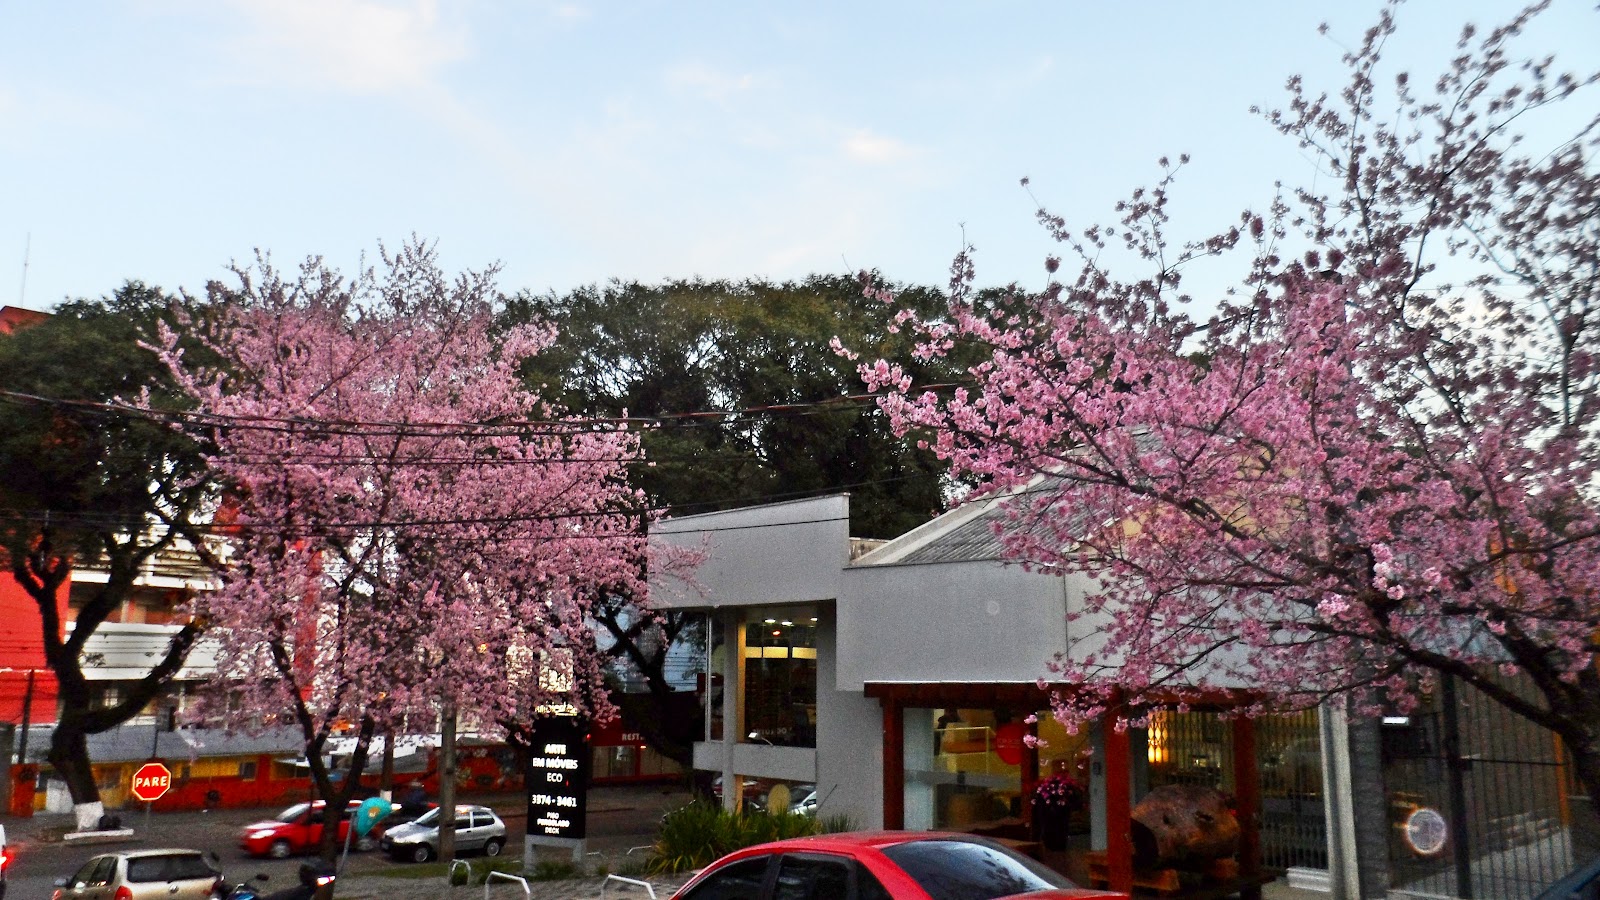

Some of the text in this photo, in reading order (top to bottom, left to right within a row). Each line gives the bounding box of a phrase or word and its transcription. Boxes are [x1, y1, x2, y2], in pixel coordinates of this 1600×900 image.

[545, 744, 566, 754] ARTE
[533, 756, 578, 769] EM MÓVEIS
[136, 776, 167, 787] PARE
[546, 772, 563, 782] ECO
